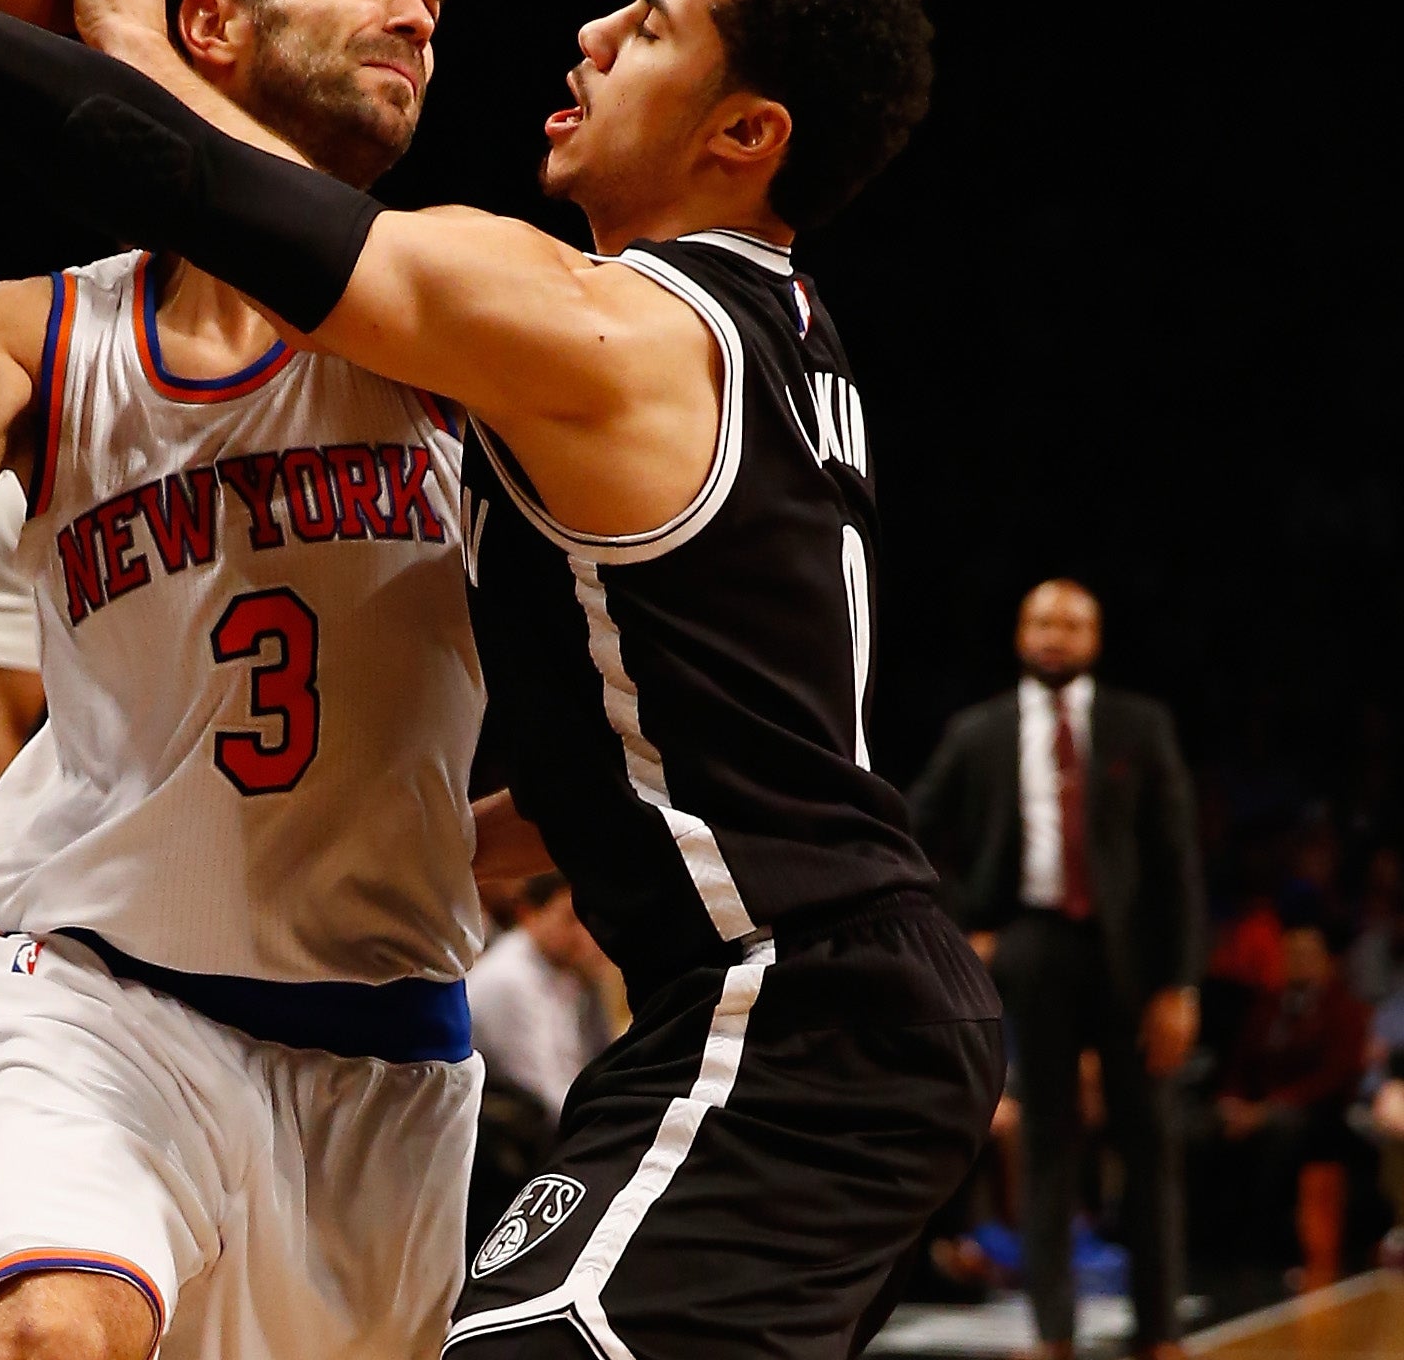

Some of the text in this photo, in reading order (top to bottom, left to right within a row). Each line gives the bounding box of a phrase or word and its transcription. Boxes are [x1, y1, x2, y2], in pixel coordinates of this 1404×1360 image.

[56, 466, 221, 627] NEW
[214, 443, 446, 551] YORK
[210, 585, 321, 797] 3
